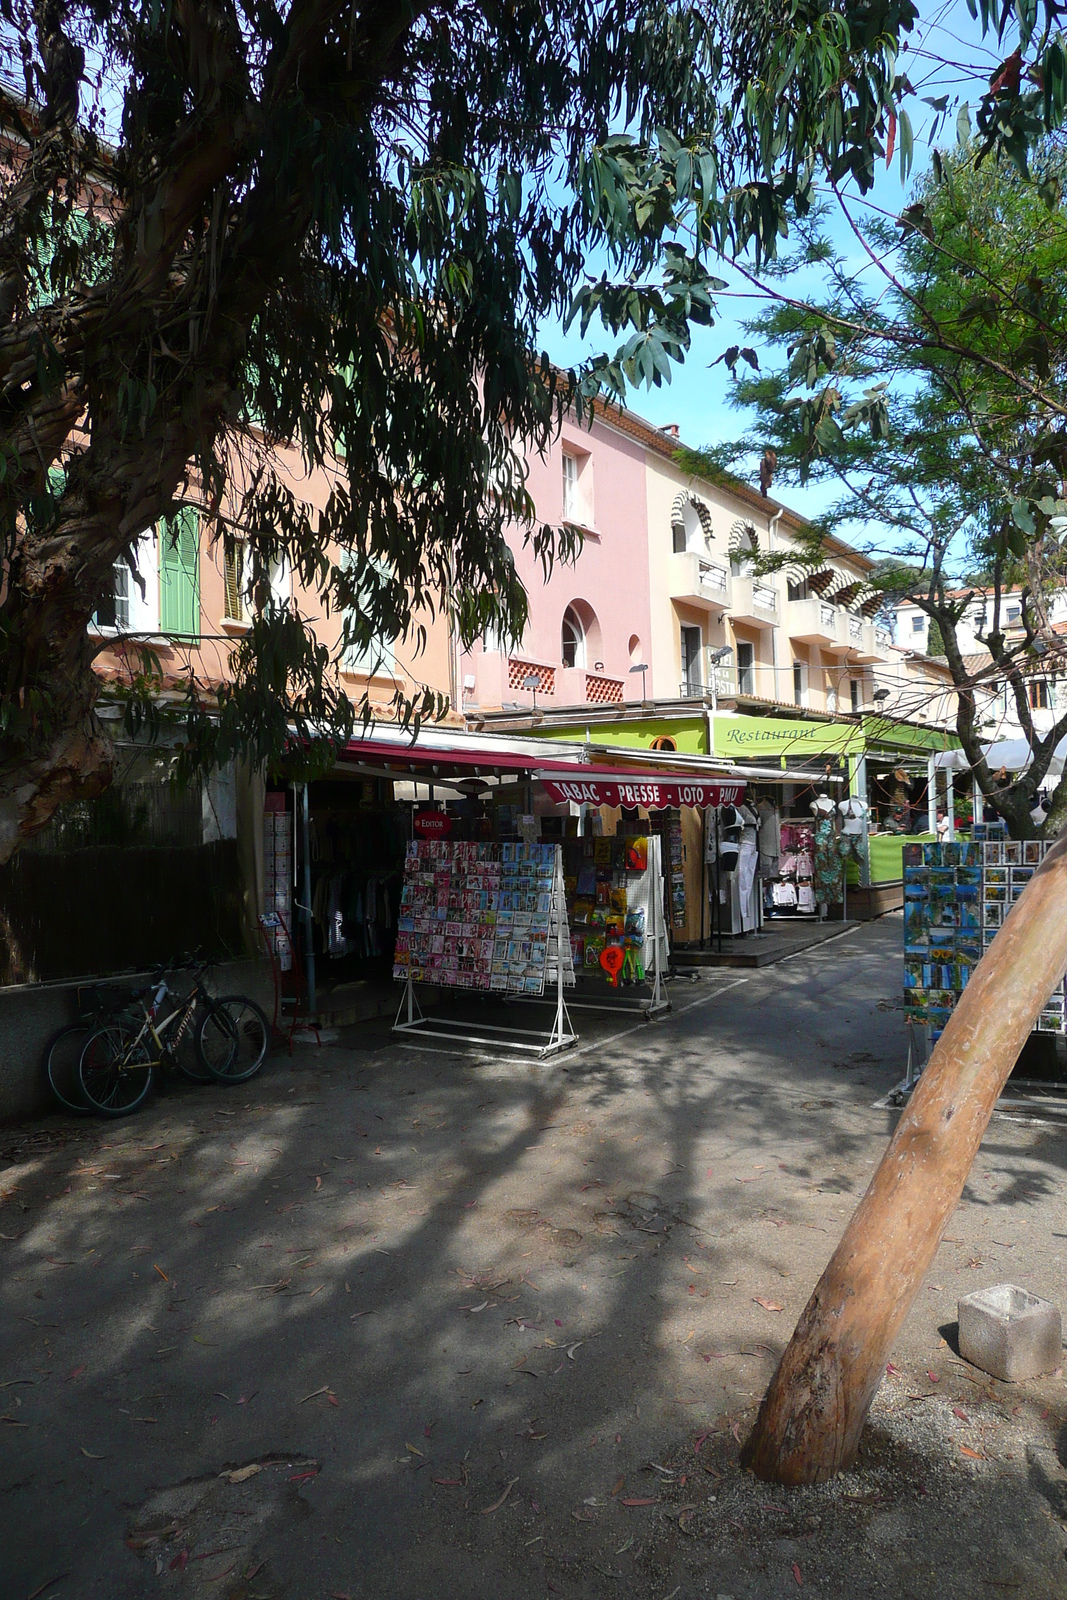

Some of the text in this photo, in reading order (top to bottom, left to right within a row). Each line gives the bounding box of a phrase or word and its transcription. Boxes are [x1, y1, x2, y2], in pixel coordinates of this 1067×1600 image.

[708, 648, 734, 667] HTEL
[726, 727, 817, 744] Restaurant
[552, 782, 600, 801] TABAC
[618, 784, 660, 802] PRESSE
[678, 786, 704, 803] LOTO
[719, 787, 739, 803] PMU
[421, 819, 443, 828] EDITOR
